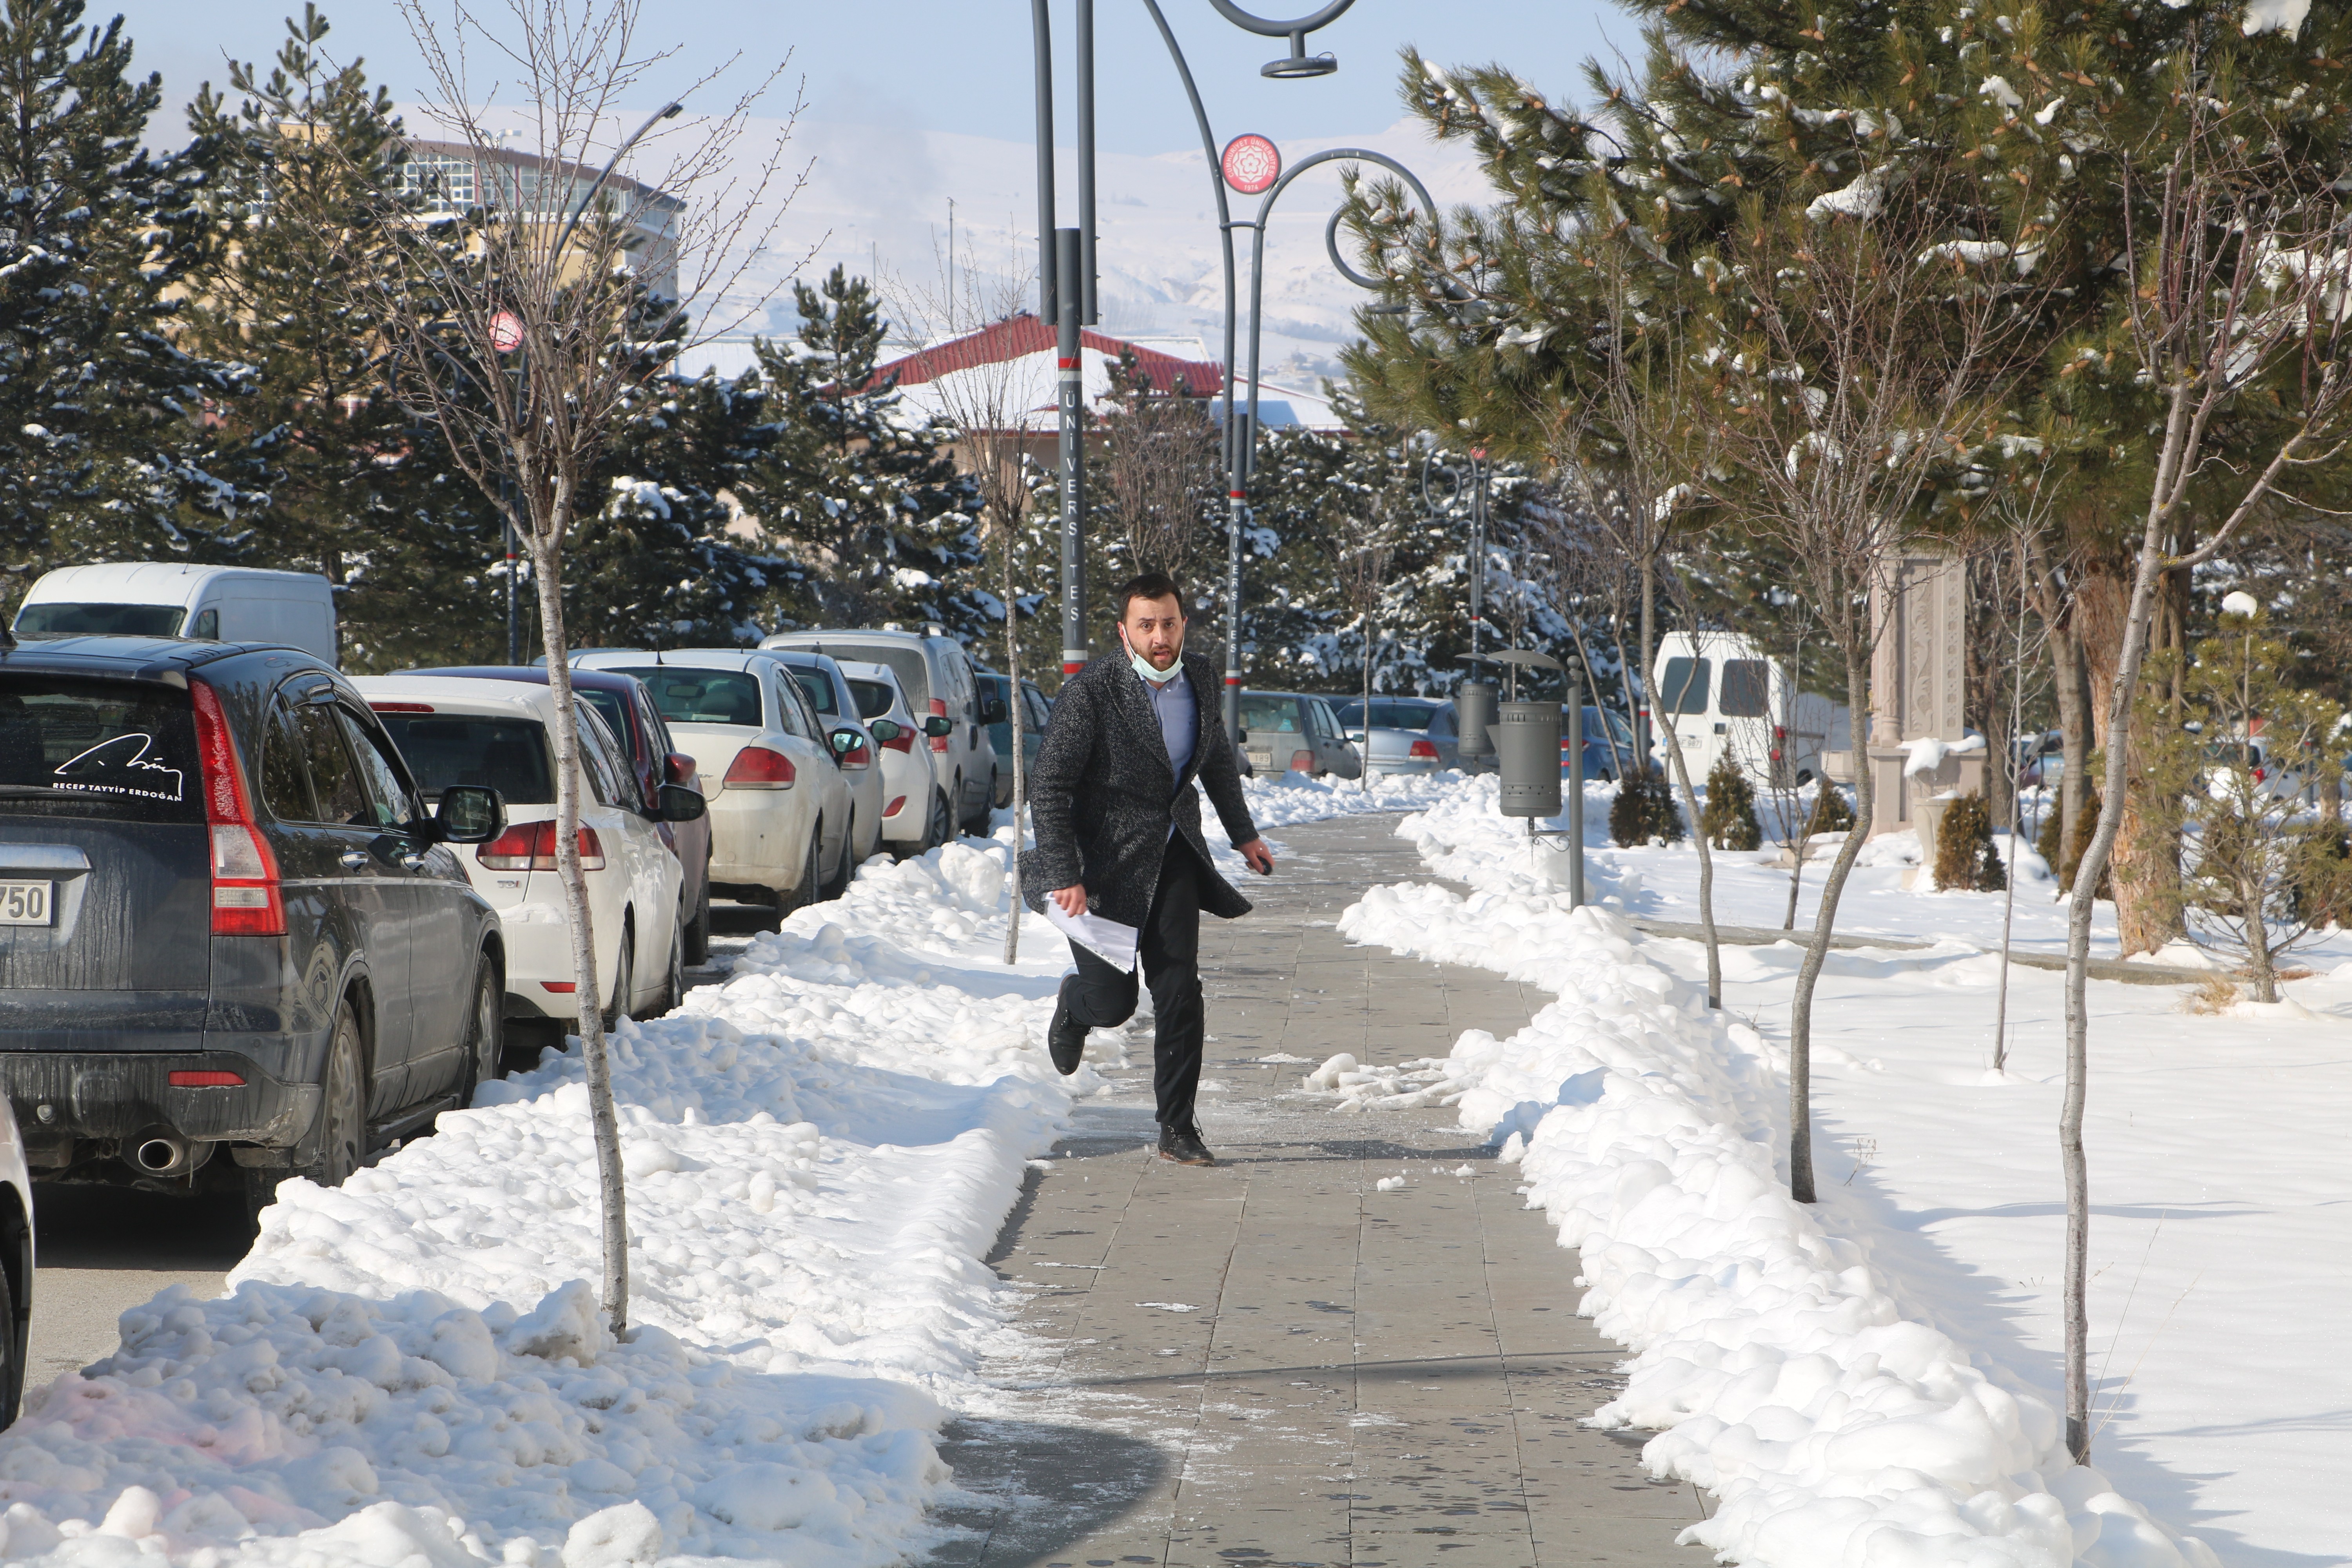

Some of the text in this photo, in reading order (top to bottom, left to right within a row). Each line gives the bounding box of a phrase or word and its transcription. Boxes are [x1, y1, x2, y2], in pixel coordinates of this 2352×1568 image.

[1226, 139, 1248, 177] CUMHURİYET
[1065, 390, 1079, 642] ÜNİVERSİTESİ
[1230, 511, 1240, 665] ÜNİVERSİTESİ
[89, 785, 125, 793] TAYYİP
[129, 788, 182, 802] ERDOĞAN
[497, 880, 521, 889] TDI
